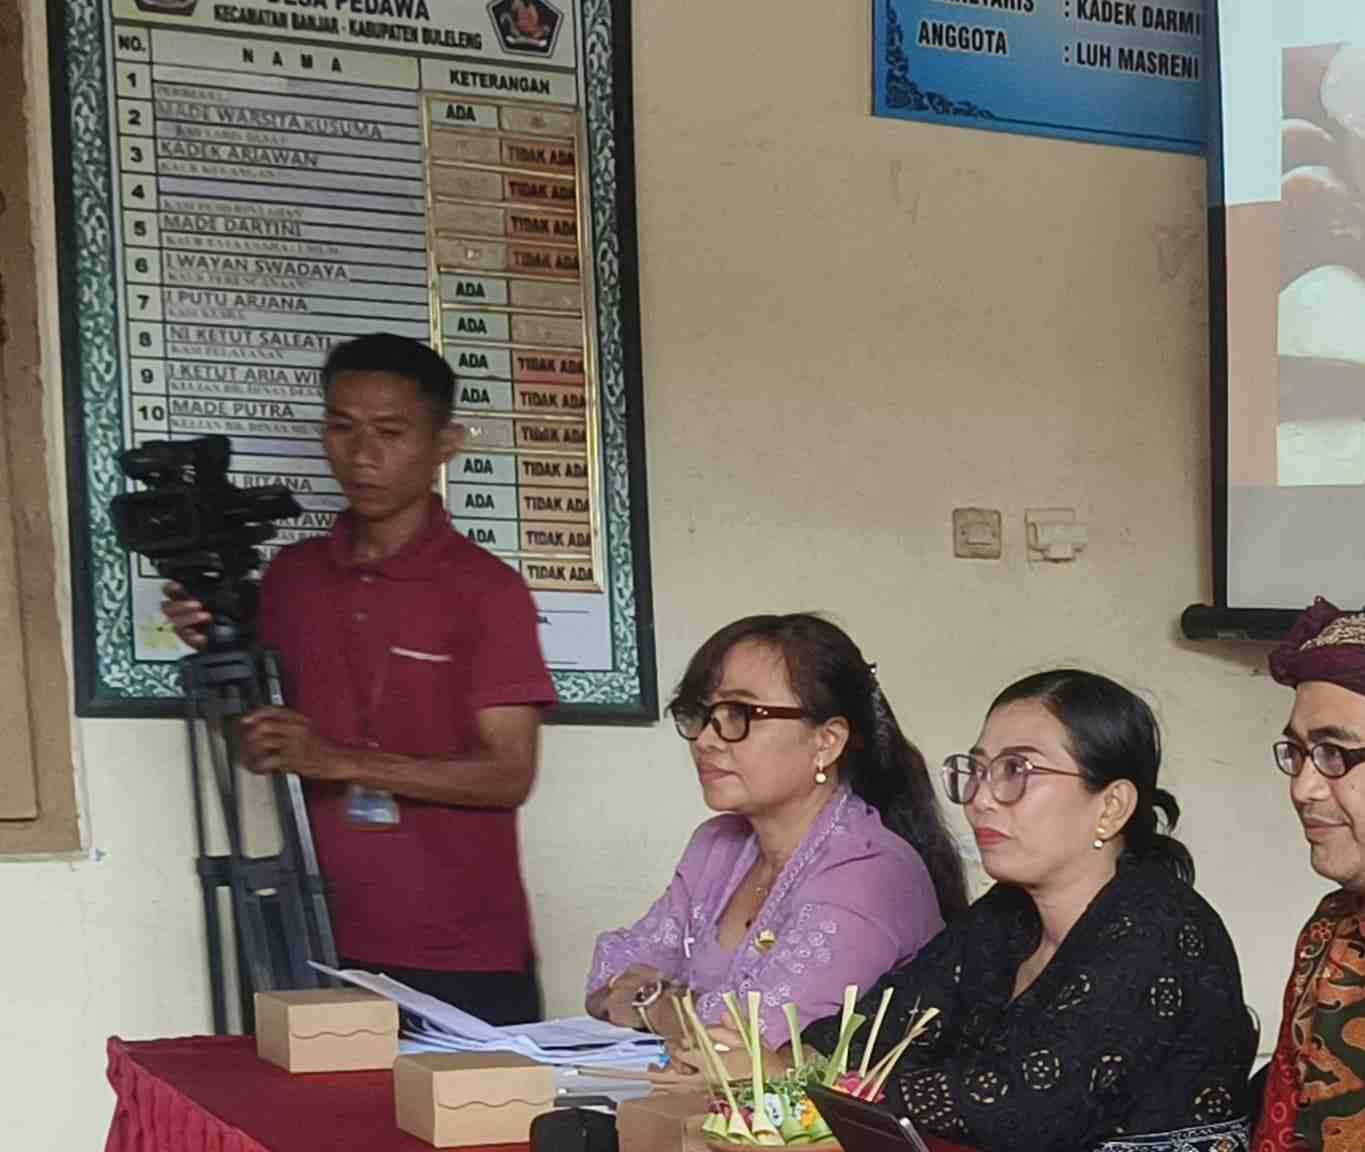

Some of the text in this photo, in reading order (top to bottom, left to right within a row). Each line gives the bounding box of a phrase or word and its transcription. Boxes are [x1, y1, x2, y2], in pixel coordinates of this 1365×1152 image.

[1076, 0, 1136, 26] KADEK
[1142, 6, 1200, 35] DARMI
[421, 27, 483, 50] BULELENG
[918, 20, 1007, 55] ANGGOTA
[118, 34, 146, 52] NO.
[450, 69, 550, 95] KETERANGAN
[1076, 42, 1112, 68] LUH
[1118, 47, 1199, 80] MASRENI
[126, 72, 137, 88] 1
[128, 110, 141, 126] 2
[445, 103, 477, 122] ADA
[130, 147, 142, 162] 3
[131, 184, 145, 199] 4
[133, 221, 147, 237] 5
[135, 257, 148, 273] 6
[176, 253, 249, 272] WAYAN
[455, 282, 486, 299] ADA
[136, 294, 150, 310] 7
[457, 316, 487, 334] ADA
[138, 332, 152, 347] 8
[458, 353, 489, 370] ADA
[140, 368, 154, 384] 9
[460, 387, 491, 405] ADA
[520, 391, 559, 407] TIDAK
[138, 406, 165, 421] 10
[233, 402, 294, 418] PUTRA
[463, 457, 494, 474] ADA
[522, 460, 562, 478] TIDAK
[465, 493, 495, 509] ADA
[524, 495, 563, 512] TIDAK
[467, 528, 496, 544] ADA
[526, 530, 565, 546] TIDAK
[527, 565, 566, 581] TIDAK
